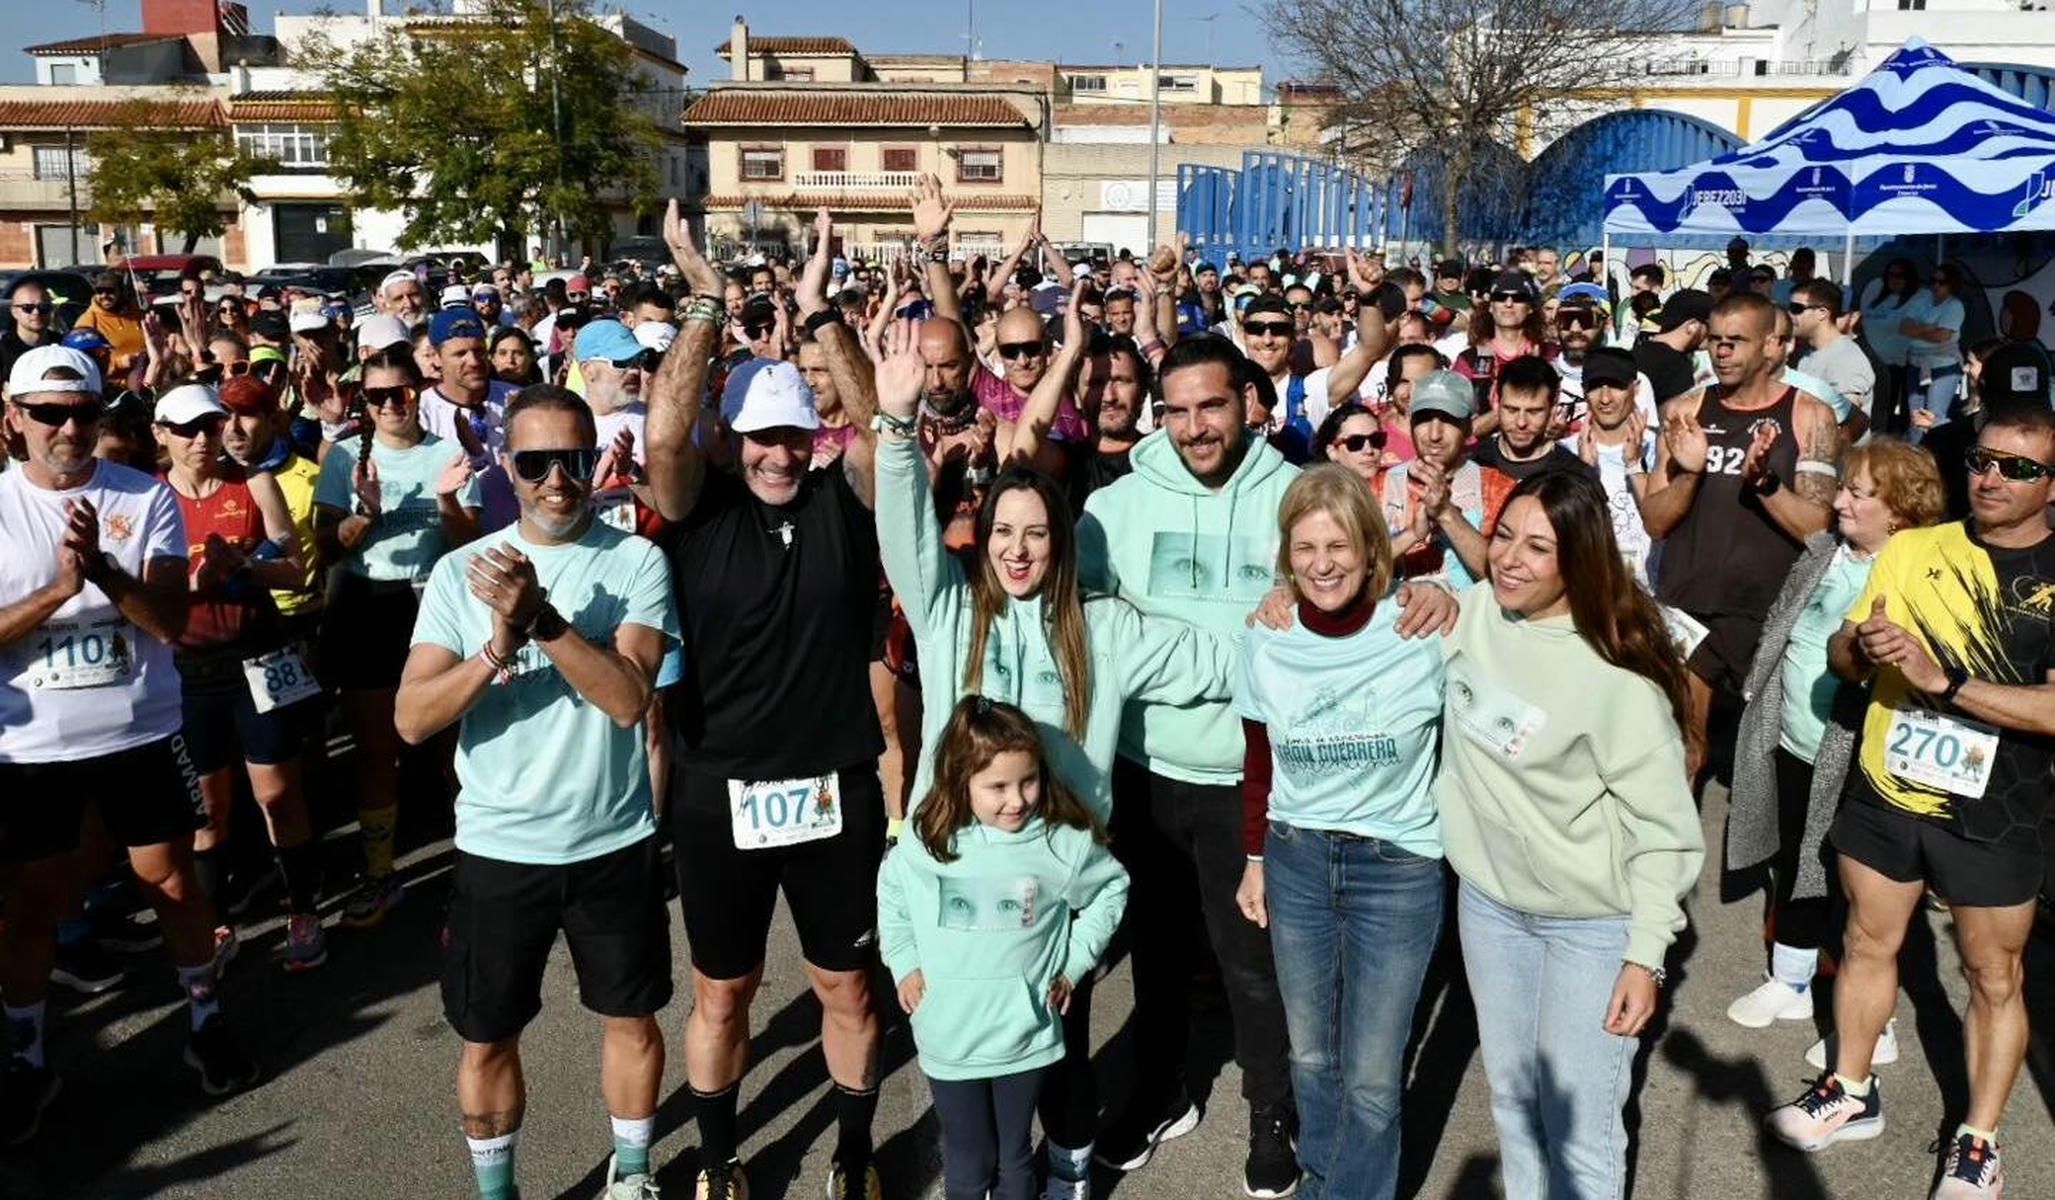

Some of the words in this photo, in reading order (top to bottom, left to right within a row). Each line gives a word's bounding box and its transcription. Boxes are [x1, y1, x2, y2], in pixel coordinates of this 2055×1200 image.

[1706, 445, 1745, 475] 92
[38, 634, 104, 668] 110
[264, 662, 298, 692] 88
[1890, 722, 1961, 768] 270
[744, 787, 810, 830] 107
